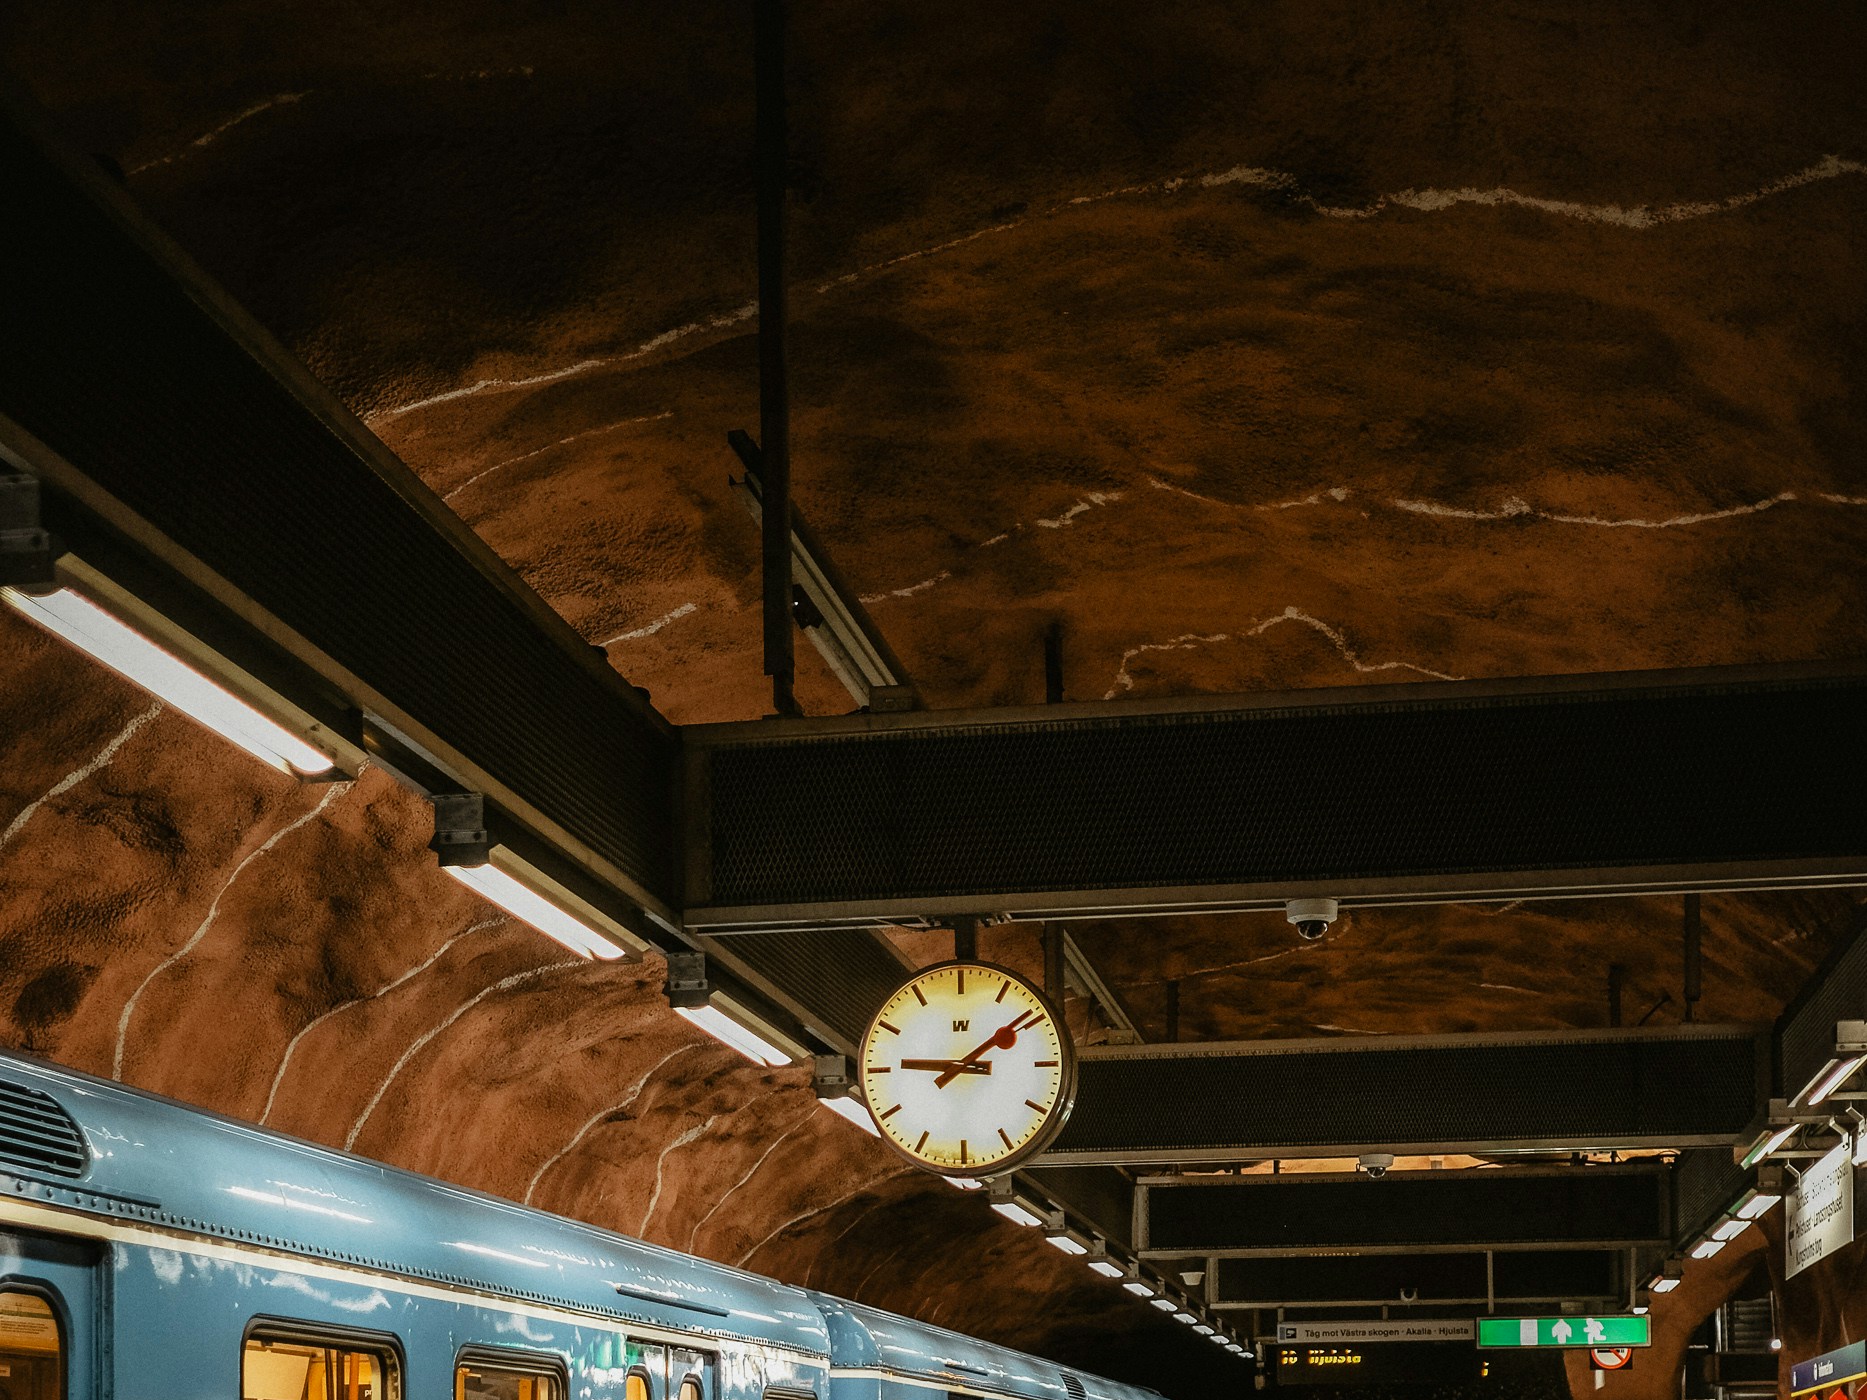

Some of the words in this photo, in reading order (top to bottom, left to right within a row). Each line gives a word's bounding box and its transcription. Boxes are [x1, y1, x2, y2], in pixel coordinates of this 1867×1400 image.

[953, 1020, 969, 1031] W
[1305, 1329, 1320, 1338] Tåg
[1322, 1329, 1339, 1337] mot
[1340, 1328, 1367, 1337] Västra
[1368, 1328, 1400, 1338] skogen
[1406, 1327, 1432, 1336] Akalla
[1439, 1327, 1469, 1336] Hjulsta
